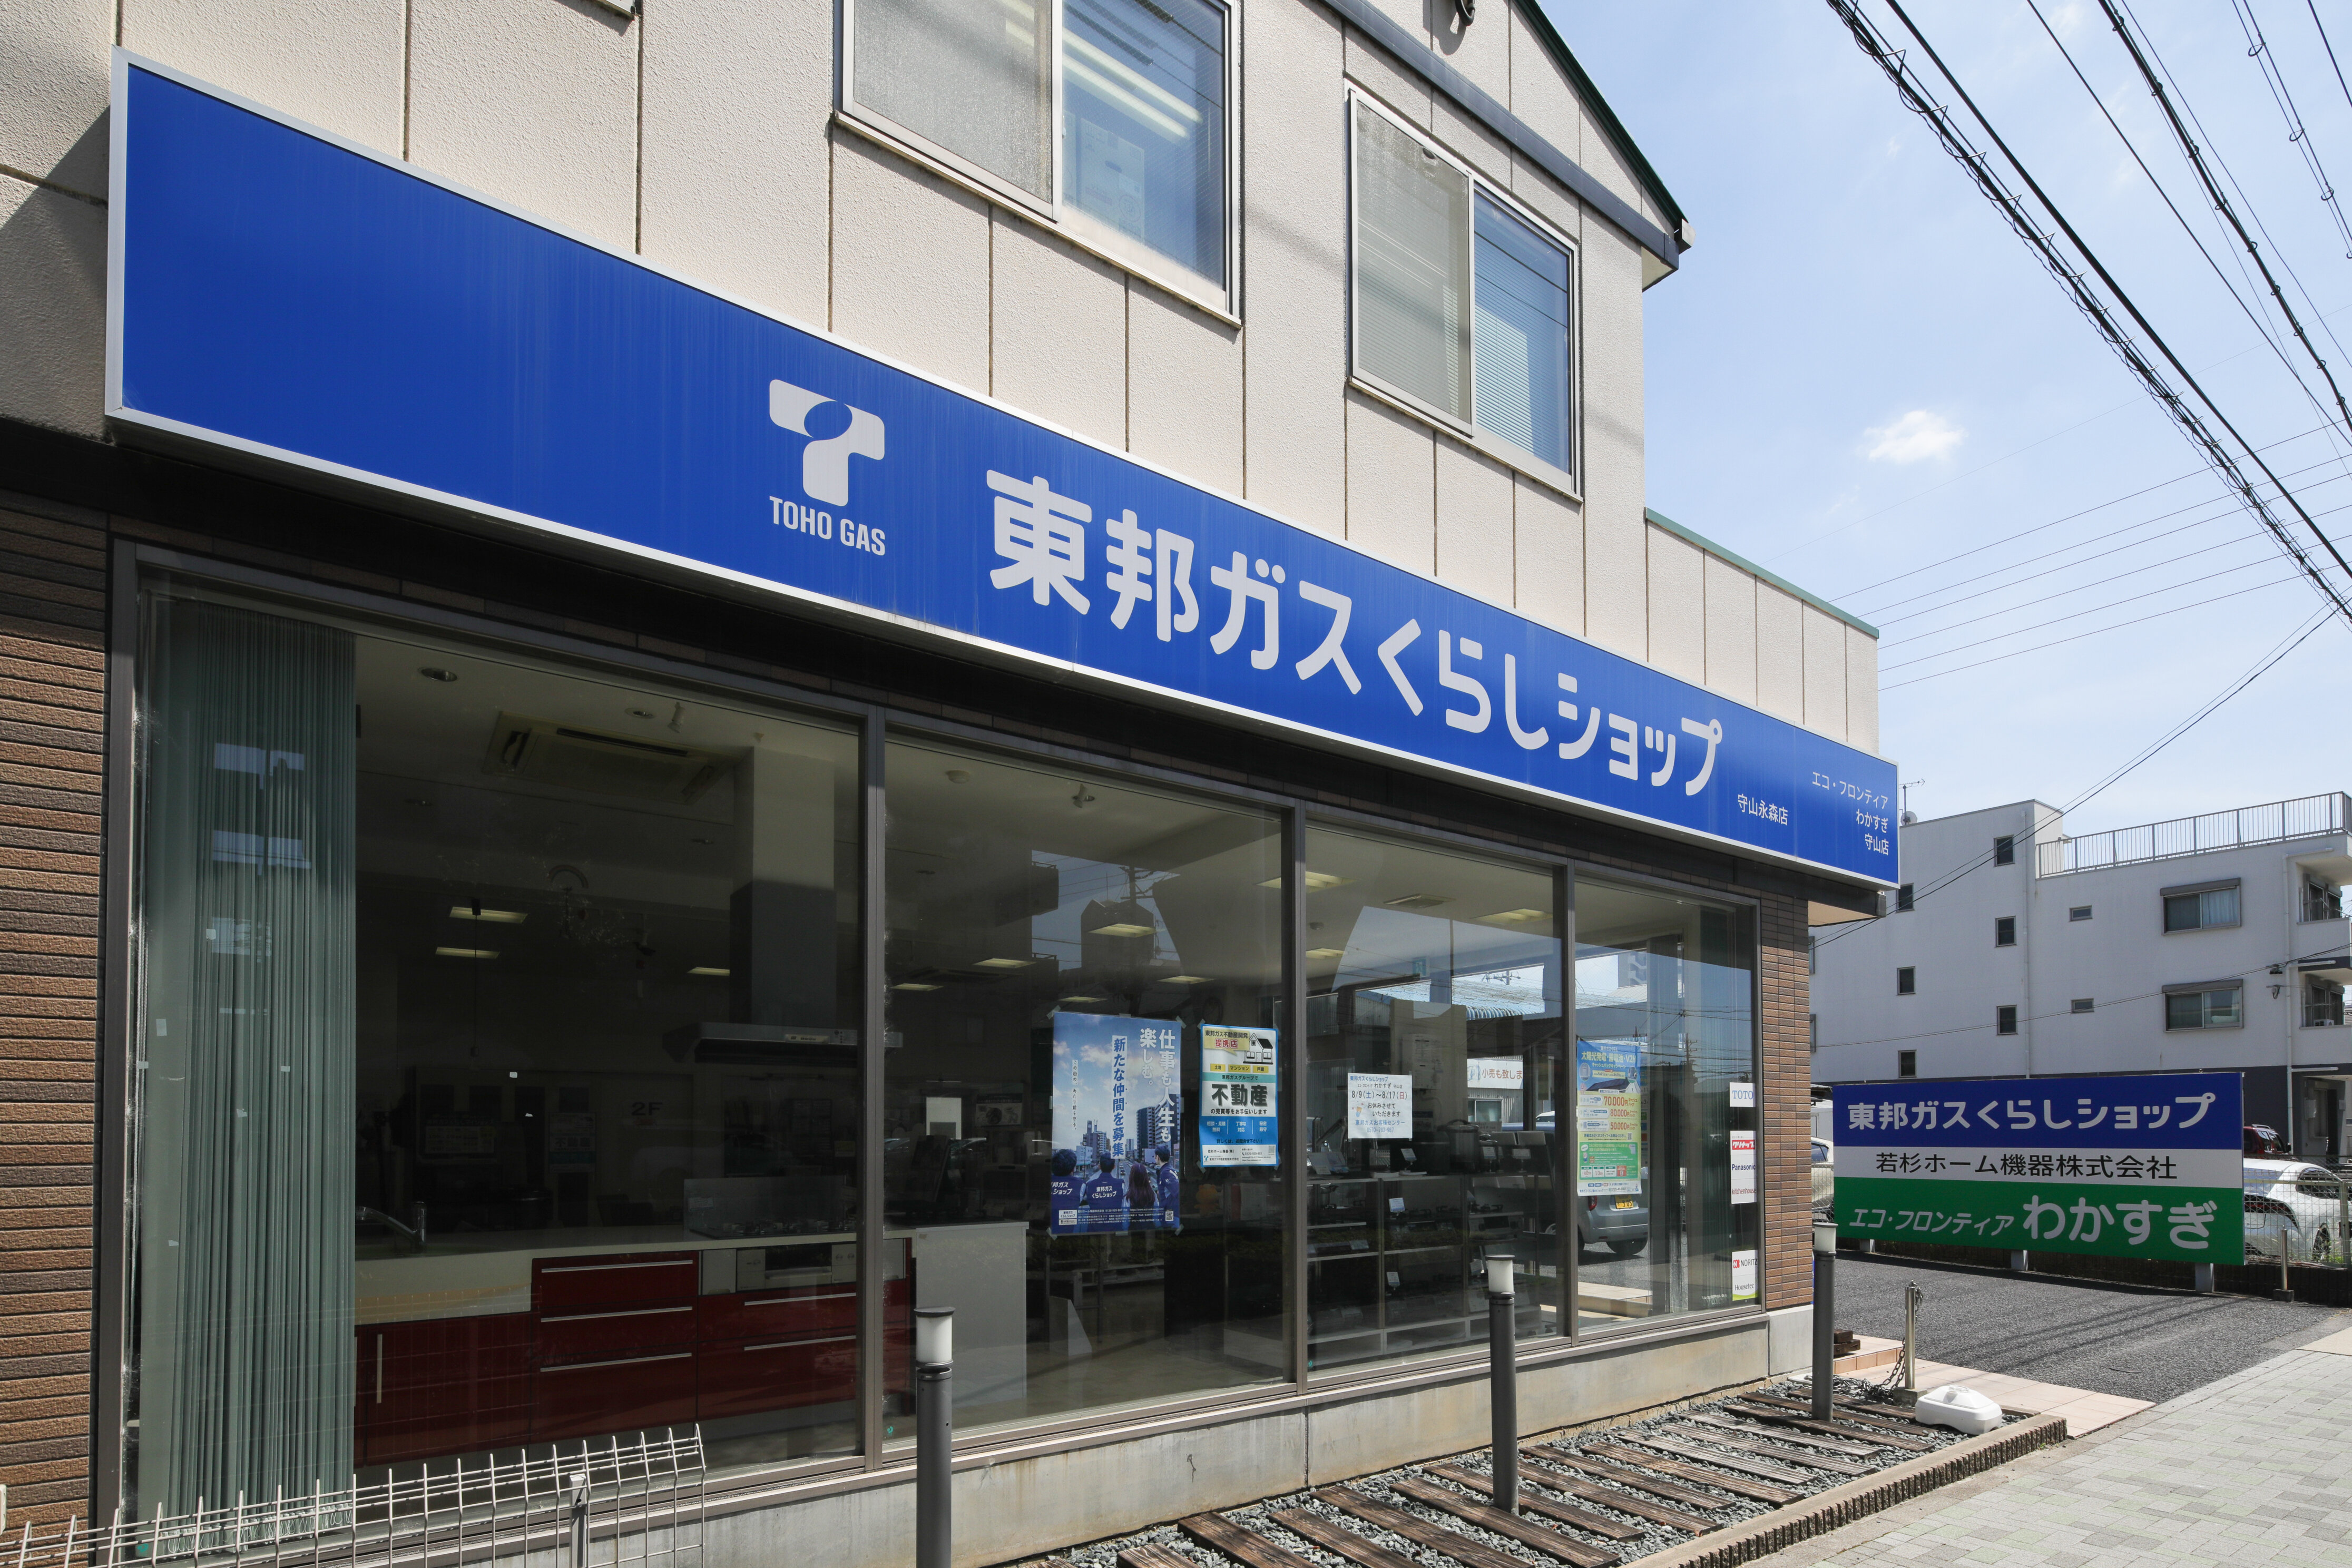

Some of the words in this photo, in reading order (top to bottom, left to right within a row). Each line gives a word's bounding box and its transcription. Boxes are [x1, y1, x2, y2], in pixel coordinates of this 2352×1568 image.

[770, 495, 832, 540] TOHO
[840, 518, 886, 556] GAS
[986, 469, 1722, 796] 東邦ガスくらしショップ
[1812, 771, 1888, 809] エコ・フロンティア
[1738, 793, 1788, 826] 守山永森店
[1856, 809, 1888, 834] わかすぎ
[1865, 834, 1889, 856] 守山店
[1205, 1030, 1248, 1038] 東邦ガス不動産開発
[1216, 1039, 1238, 1048] 提携店
[1140, 1027, 1157, 1085] 楽しむ。
[1159, 1029, 1175, 1142] 仕事も人生も
[1482, 1068, 1523, 1080] 小売も致しま
[631, 1102, 663, 1116] 2F
[1112, 1037, 1125, 1157] 新たな仲間を募集
[1211, 1083, 1268, 1107] 不動産
[1732, 1090, 1753, 1100] TOTO
[1848, 1092, 2216, 1130] 東邦ガスくらしショップ
[1876, 1152, 2178, 1180] 若杉ホーム機器株式会社
[1849, 1208, 2014, 1236] エコ・フロンティア
[2023, 1194, 2217, 1249] わかすぎ
[1741, 1258, 1758, 1267] NORITZ
